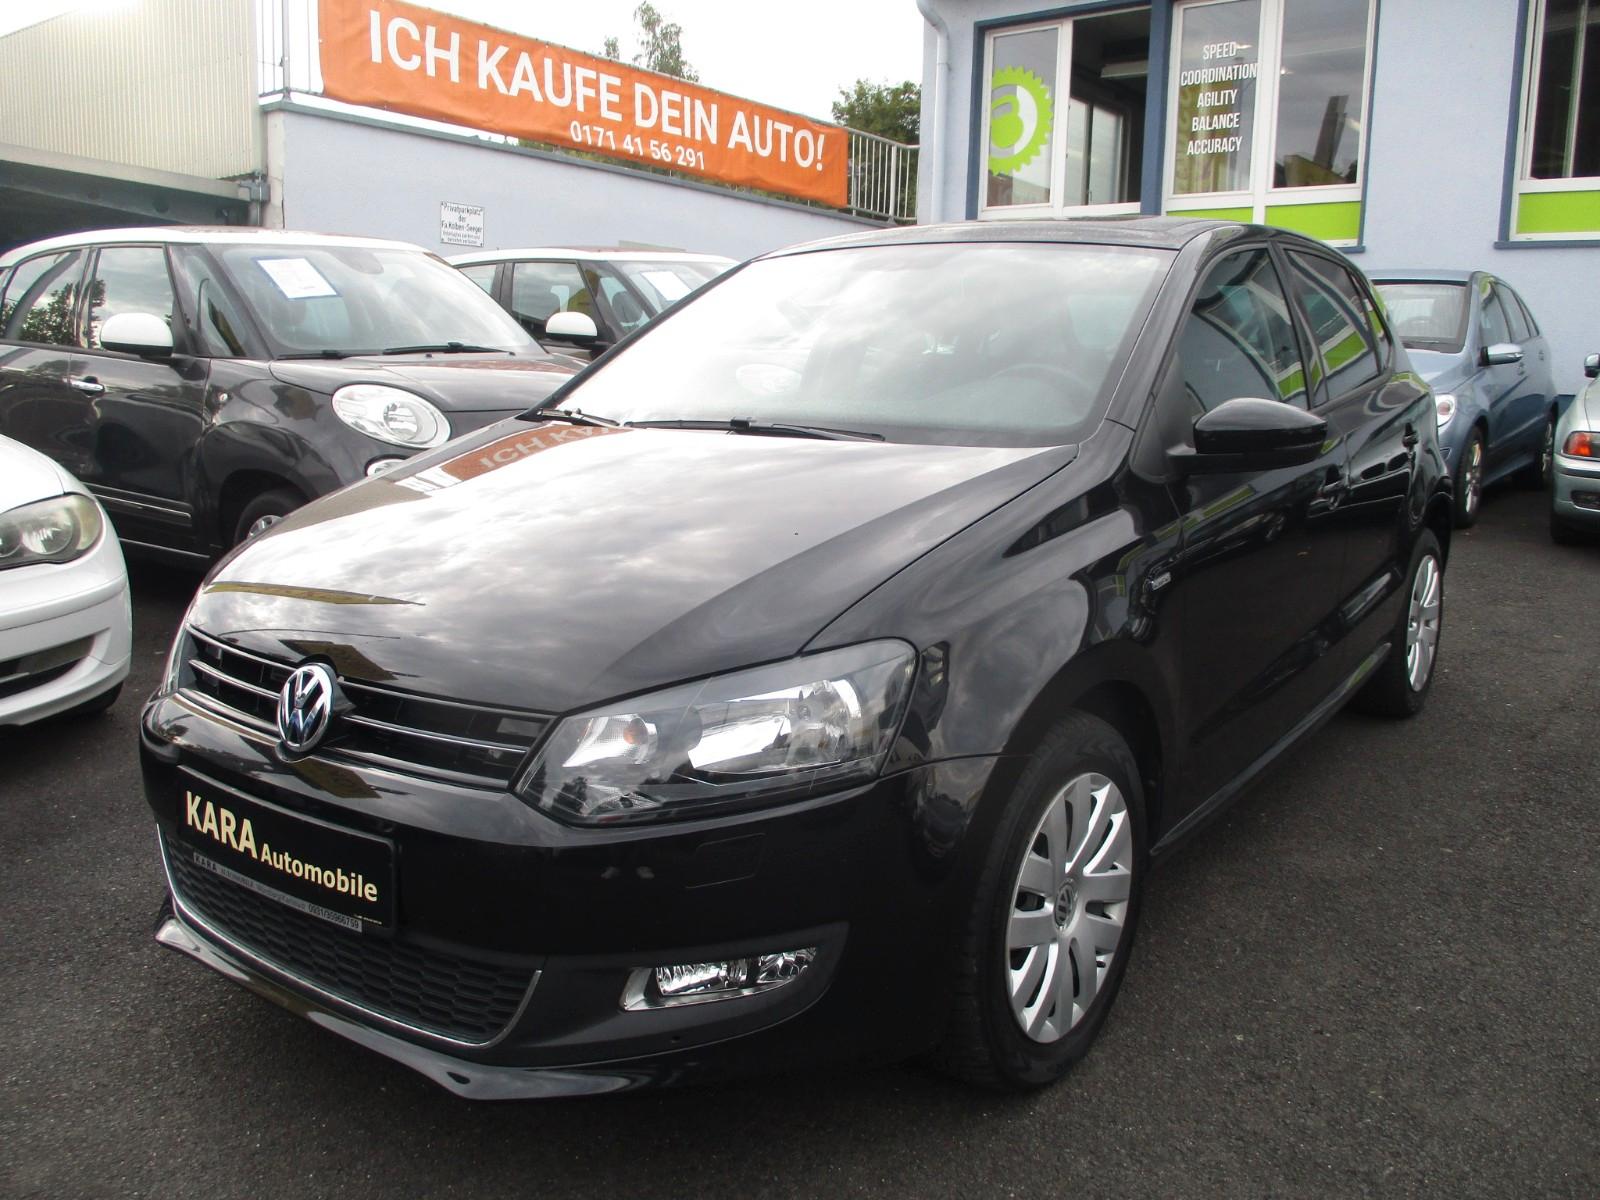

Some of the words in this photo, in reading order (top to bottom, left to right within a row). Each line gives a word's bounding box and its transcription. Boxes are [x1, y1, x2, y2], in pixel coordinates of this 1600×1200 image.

[1203, 42, 1237, 60] SPEED
[1181, 62, 1258, 87] COORDINATION
[369, 9, 461, 83] ICH
[477, 39, 622, 122] KAUFE
[633, 82, 718, 145] DEIN
[727, 110, 825, 171] AUTO!
[1197, 89, 1238, 108] AGILITY
[1192, 112, 1240, 132] BALANCE
[569, 120, 616, 150] 0171
[623, 134, 644, 156] 41
[650, 139, 672, 162] 56
[676, 145, 705, 170] 291
[1187, 136, 1243, 156] ACCURACY
[186, 790, 258, 860] KARA
[260, 842, 378, 902] Automobile
